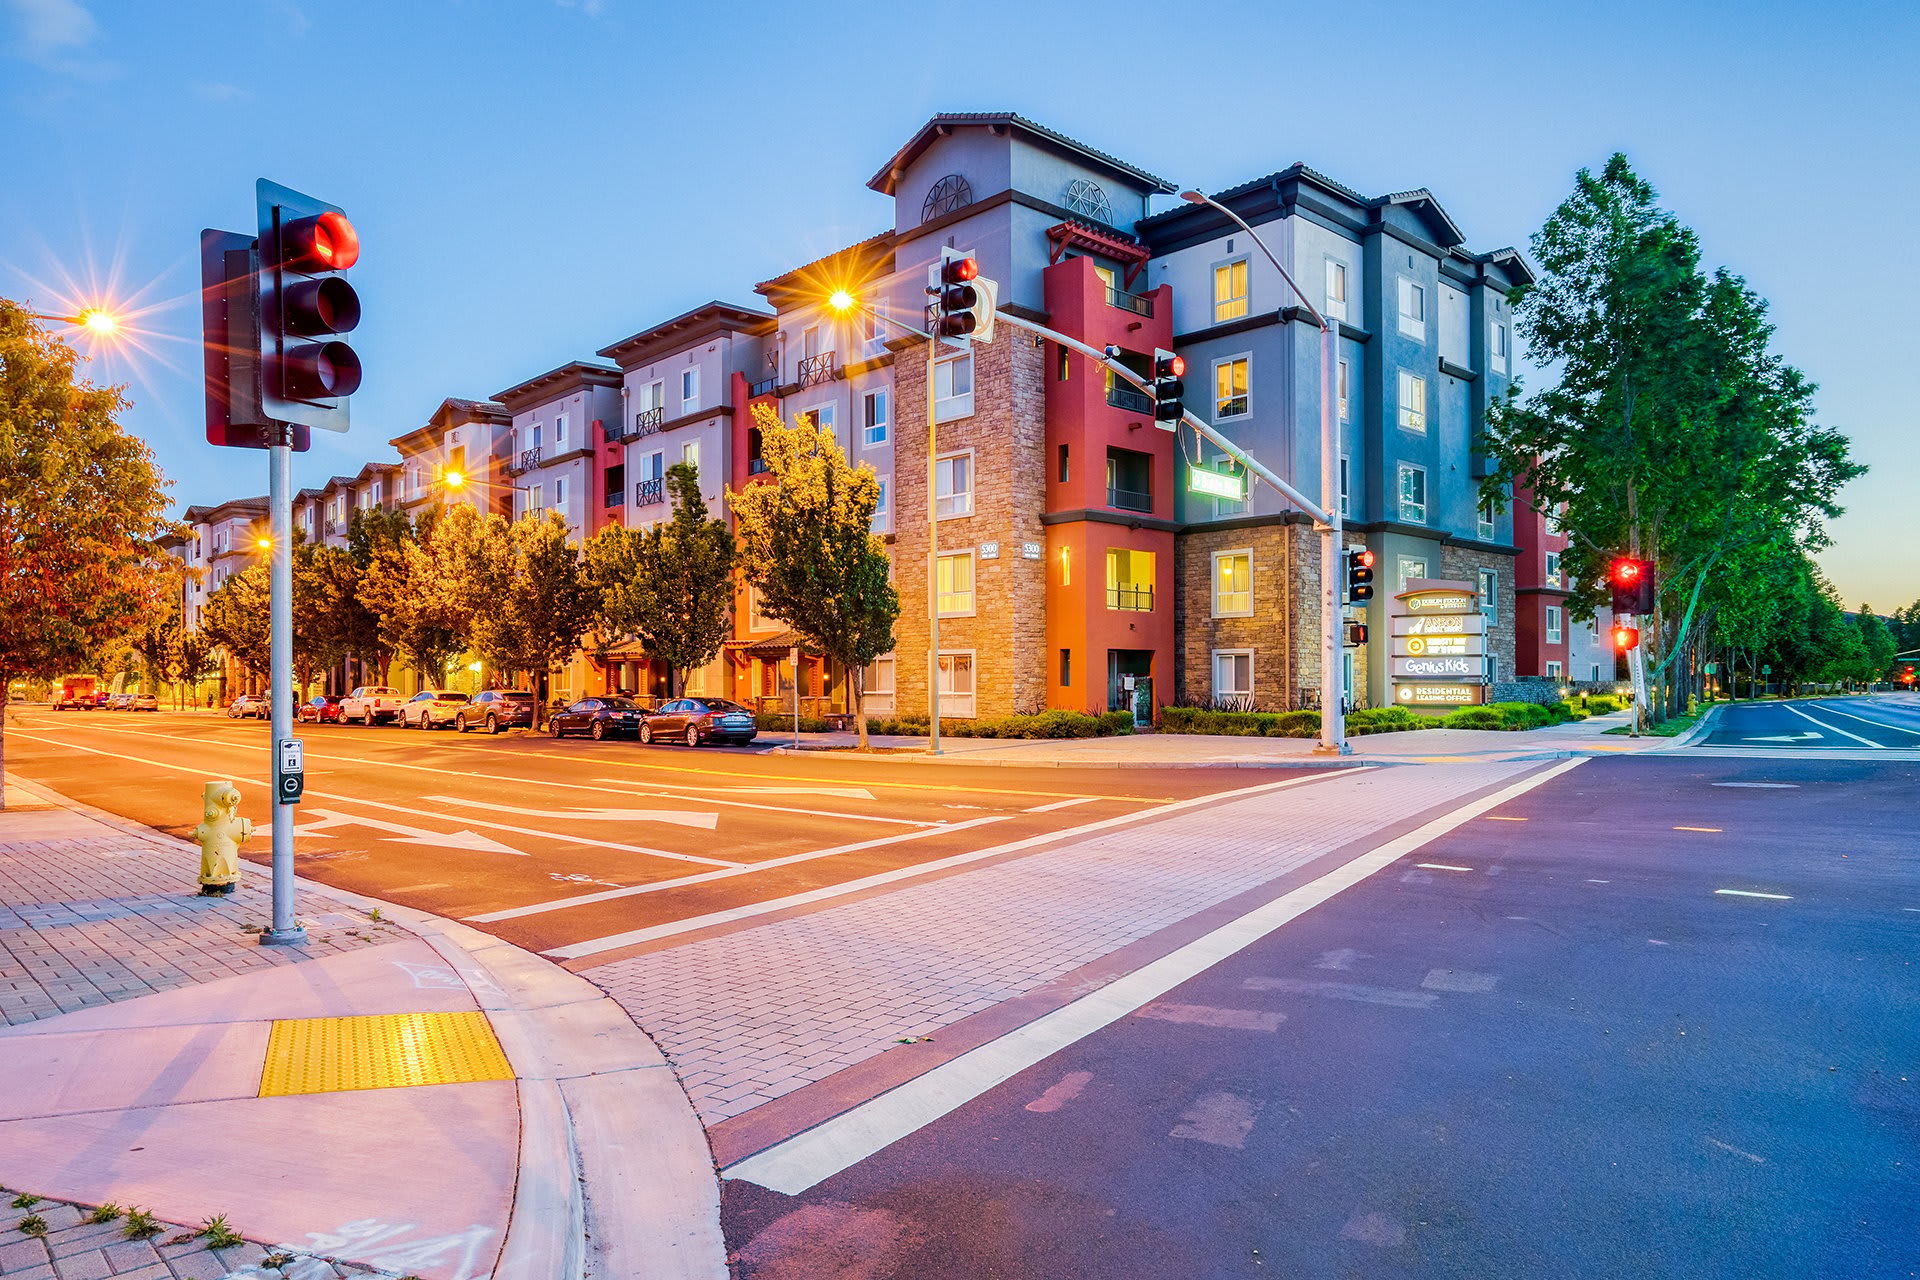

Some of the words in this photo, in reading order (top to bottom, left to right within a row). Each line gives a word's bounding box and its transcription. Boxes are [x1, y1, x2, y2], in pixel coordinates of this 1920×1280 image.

[981, 544, 997, 553] 5300
[1024, 543, 1039, 553] 5300
[1424, 617, 1463, 627] ANSON
[1405, 659, 1444, 674] Genius
[1445, 658, 1469, 673] Kids
